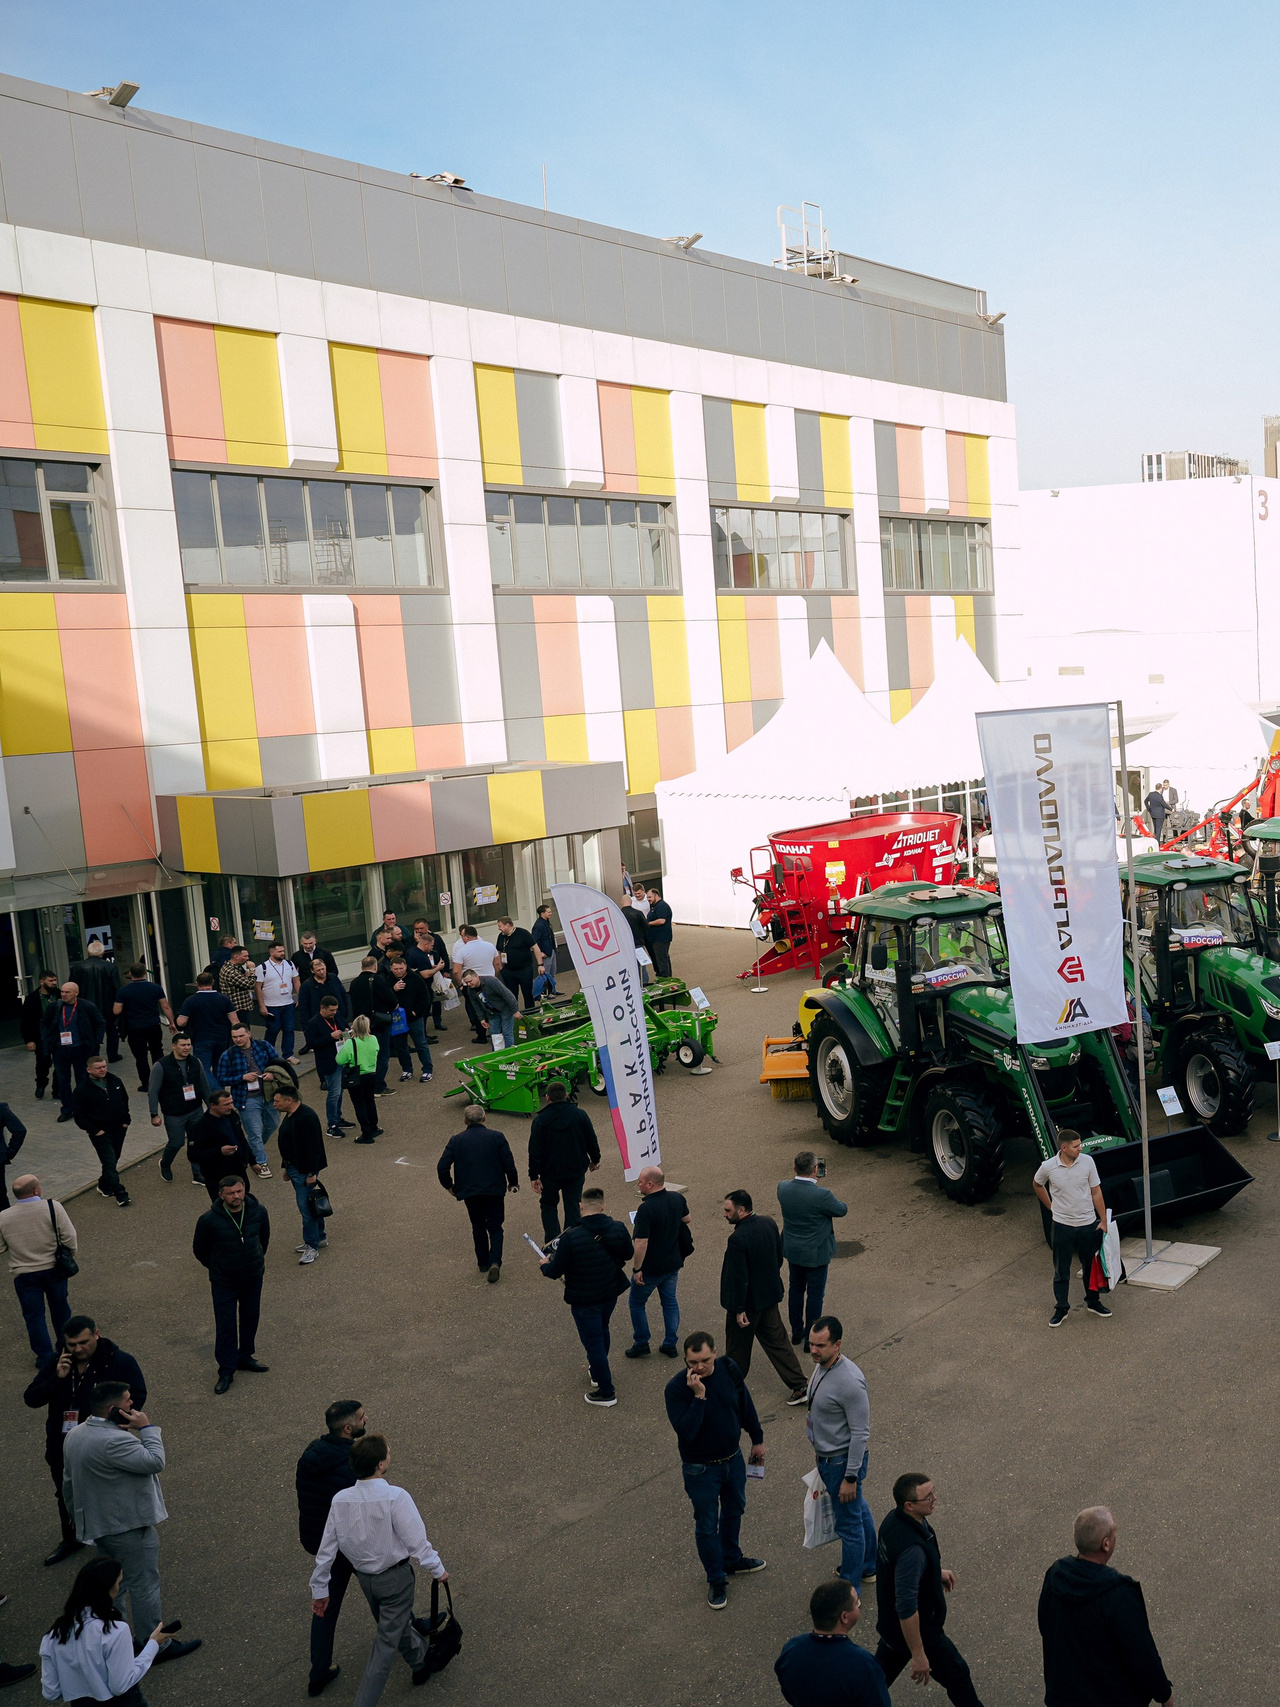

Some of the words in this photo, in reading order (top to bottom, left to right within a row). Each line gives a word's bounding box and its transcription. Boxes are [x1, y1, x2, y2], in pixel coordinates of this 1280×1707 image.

[1258, 489, 1269, 521] 3
[901, 829, 940, 848] TRIOLIET
[774, 843, 814, 855] КОЛНАГ
[903, 846, 924, 857] КОЛНАГ
[938, 971, 967, 983] РОССИИ
[559, 1010, 577, 1020] КОЛНАГ
[498, 1064, 521, 1072] КОЛНАГ
